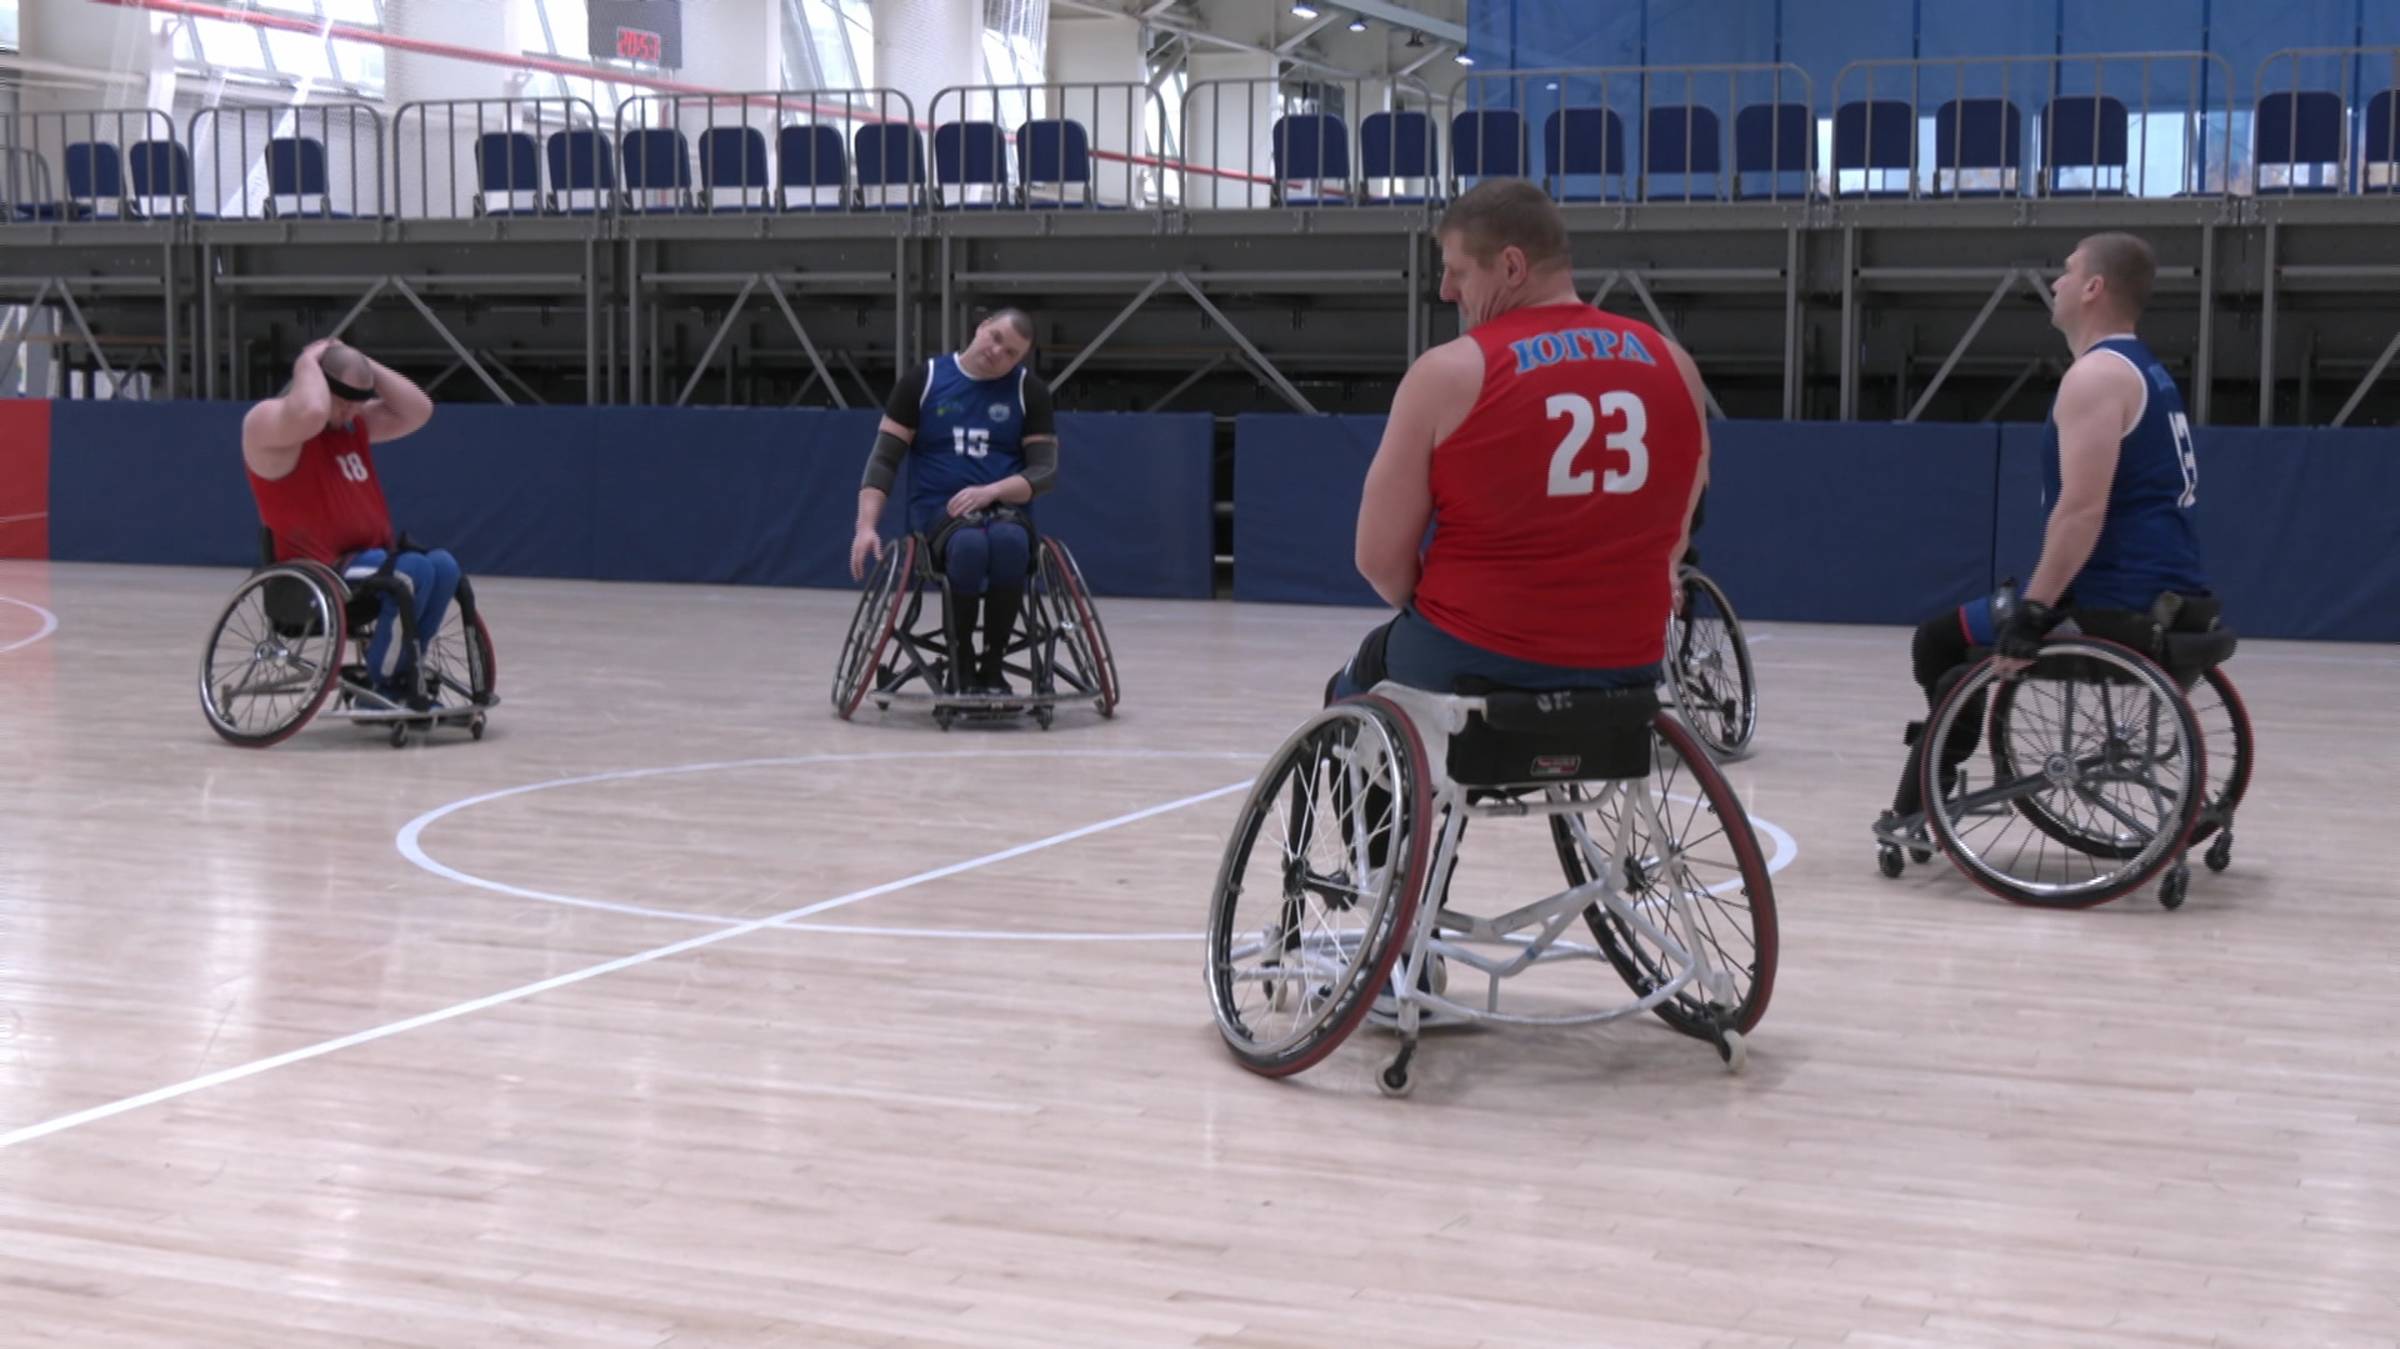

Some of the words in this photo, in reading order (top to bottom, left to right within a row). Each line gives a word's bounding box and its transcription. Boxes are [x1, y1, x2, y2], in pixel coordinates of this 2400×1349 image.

[1510, 328, 1656, 375] ЮГРА
[952, 426, 990, 459] 15
[1545, 390, 1650, 496] 23
